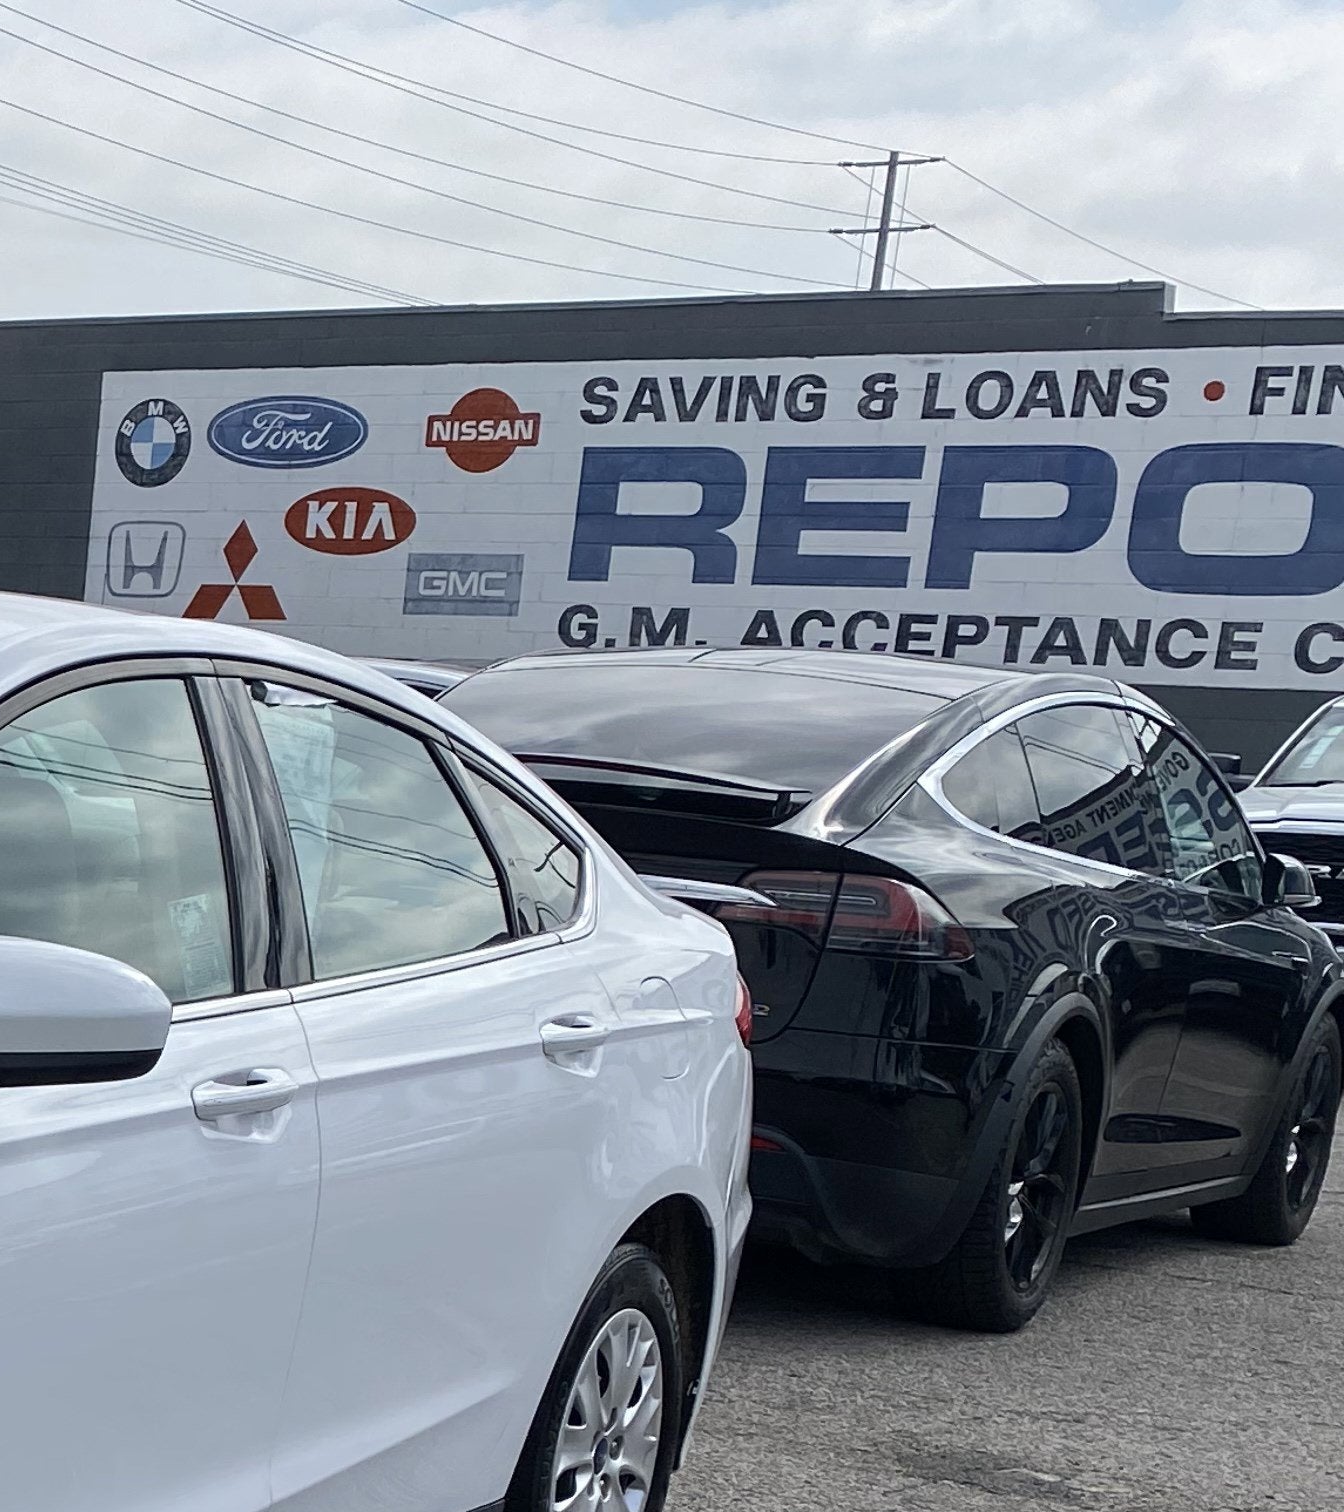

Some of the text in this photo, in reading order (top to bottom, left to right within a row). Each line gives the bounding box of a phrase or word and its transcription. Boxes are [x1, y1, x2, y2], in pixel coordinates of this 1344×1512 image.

[579, 373, 828, 424] SAVING
[857, 372, 899, 420] &
[920, 367, 1170, 420] LOANS
[120, 402, 190, 438] BMW
[240, 410, 334, 452] Ford
[431, 418, 535, 443] NISSAN
[305, 500, 397, 541] KIA
[567, 442, 1344, 596] REPO
[418, 569, 508, 598] GMC
[558, 604, 1344, 674] G.M. ACCEPTANCE C
